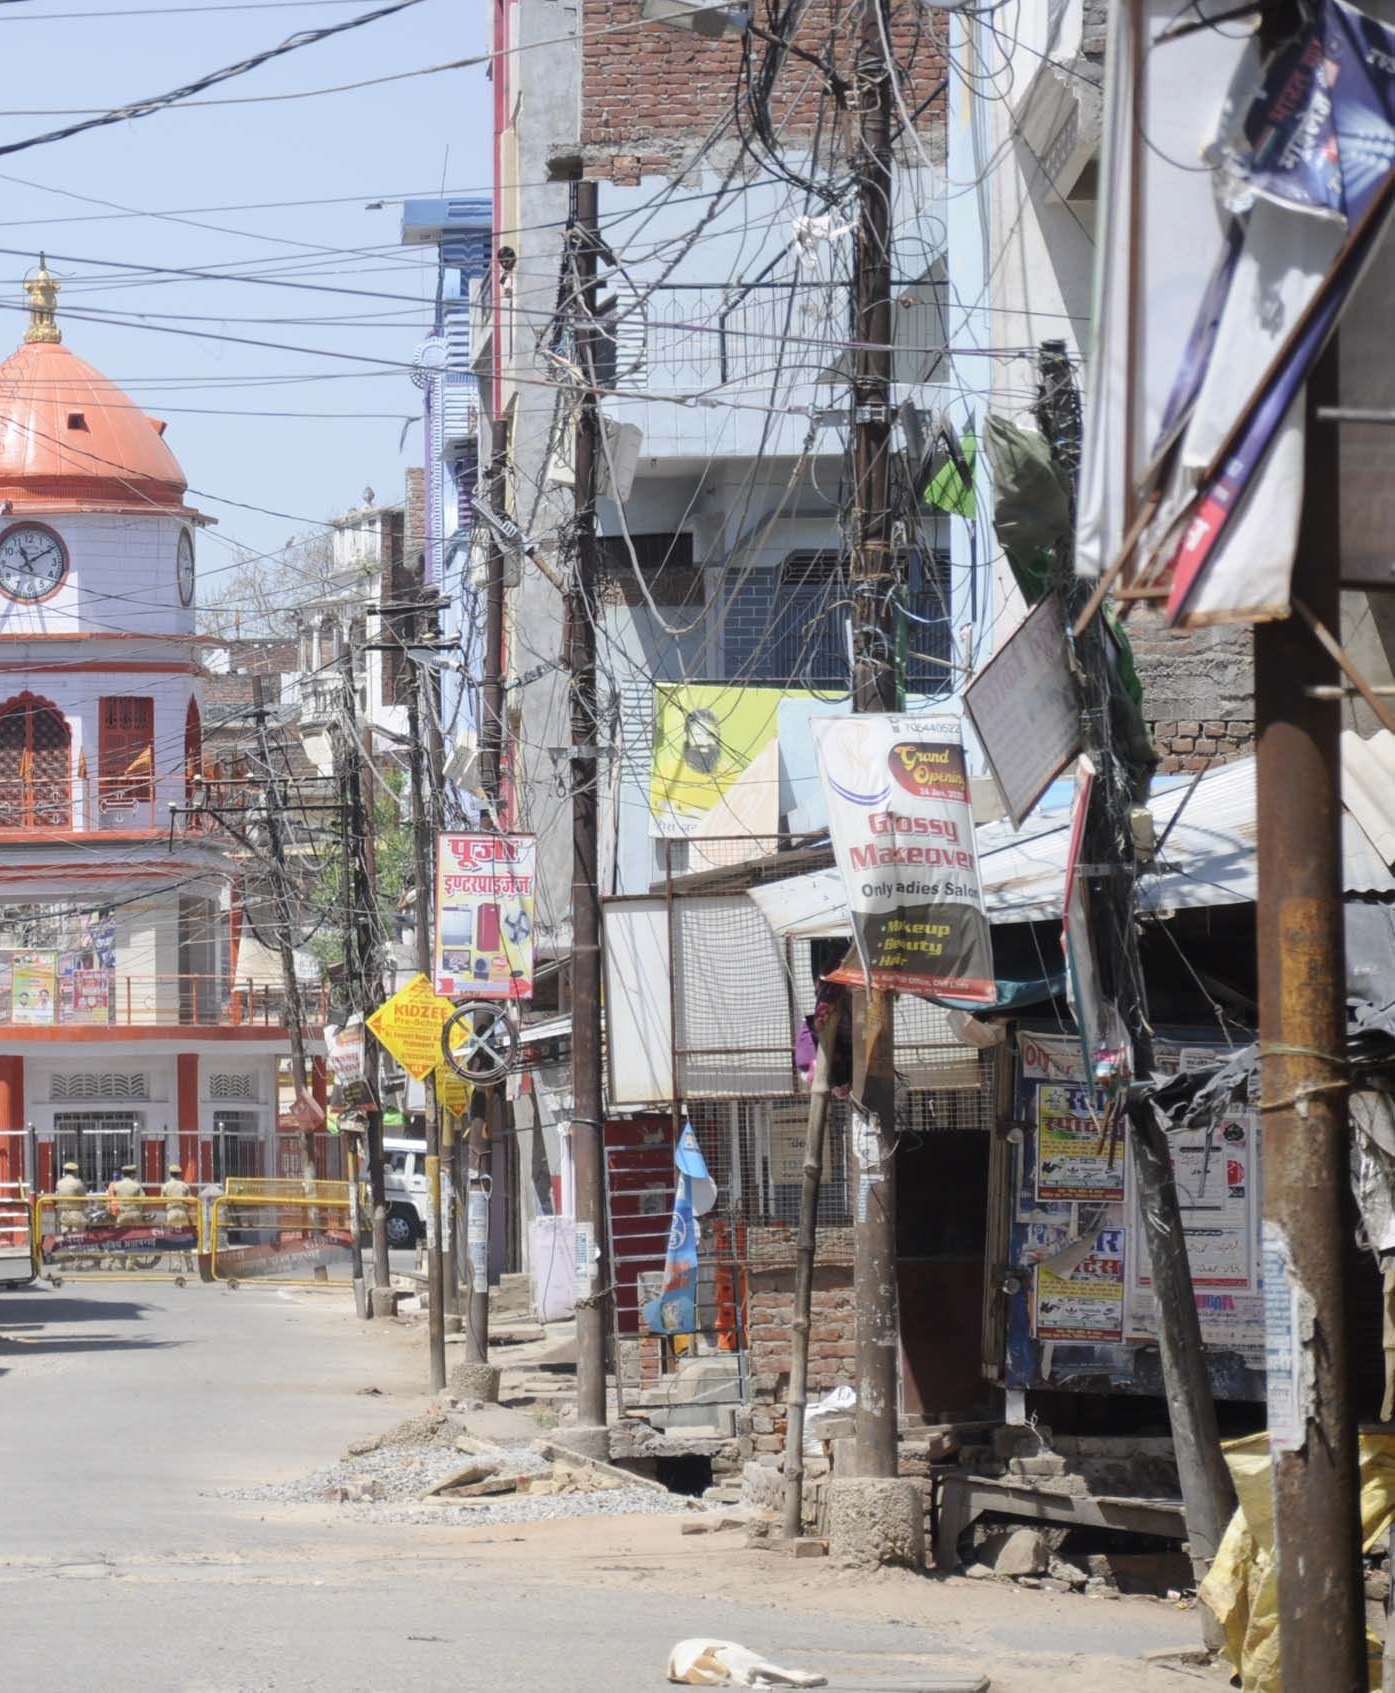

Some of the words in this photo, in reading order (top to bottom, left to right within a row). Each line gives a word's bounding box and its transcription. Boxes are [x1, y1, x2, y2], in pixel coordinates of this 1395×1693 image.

[894, 745, 950, 771] Grand
[448, 838, 520, 868] पूजा
[861, 881, 893, 899] Only
[394, 1003, 449, 1020] KIDZEE
